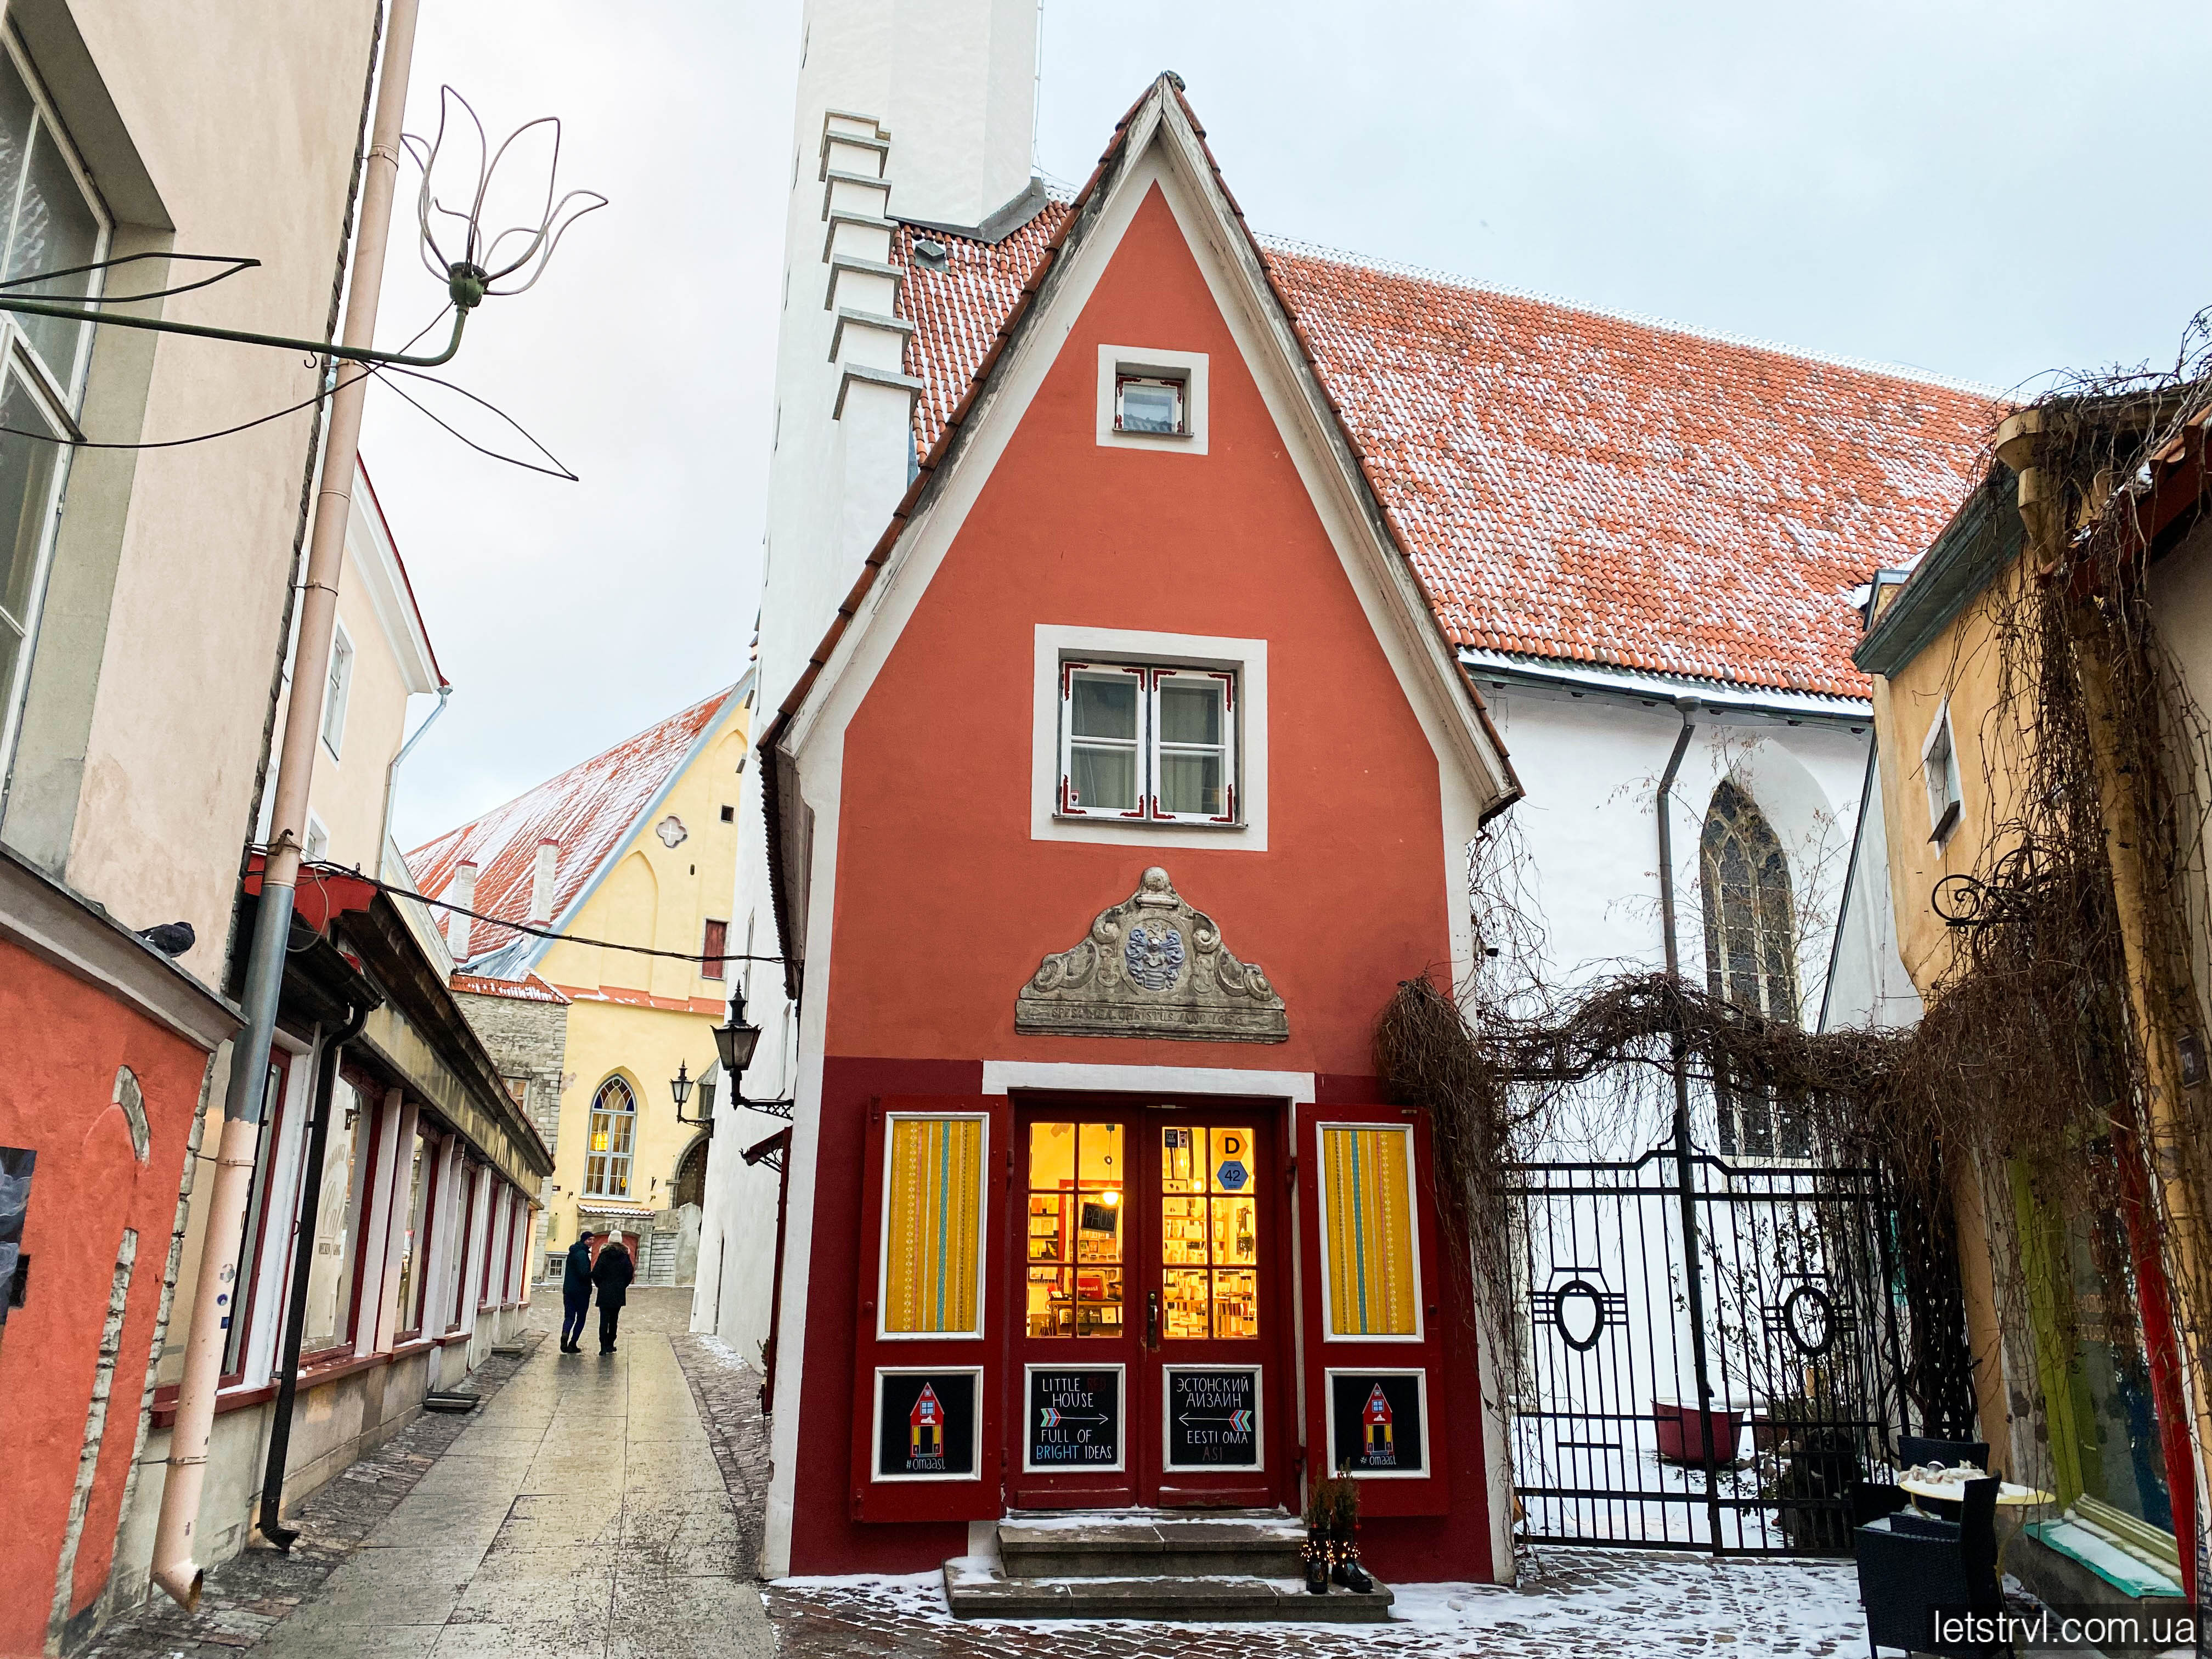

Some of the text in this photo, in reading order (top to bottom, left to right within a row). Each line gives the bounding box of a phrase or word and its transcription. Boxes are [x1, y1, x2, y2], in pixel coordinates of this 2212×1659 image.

[1225, 1137, 1240, 1154] D
[1224, 1170, 1241, 1181] 42
[1042, 1378, 1080, 1392] LITTLE
[1176, 1376, 1249, 1392] ЭСТОНСКИЙ
[1053, 1392, 1094, 1408] HOUSE
[1041, 1429, 1093, 1443] FULL OF
[1187, 1430, 1249, 1444] EESTI OMA
[1036, 1444, 1112, 1460] BRIGHT IDEAS
[1202, 1446, 1223, 1462] ASI
